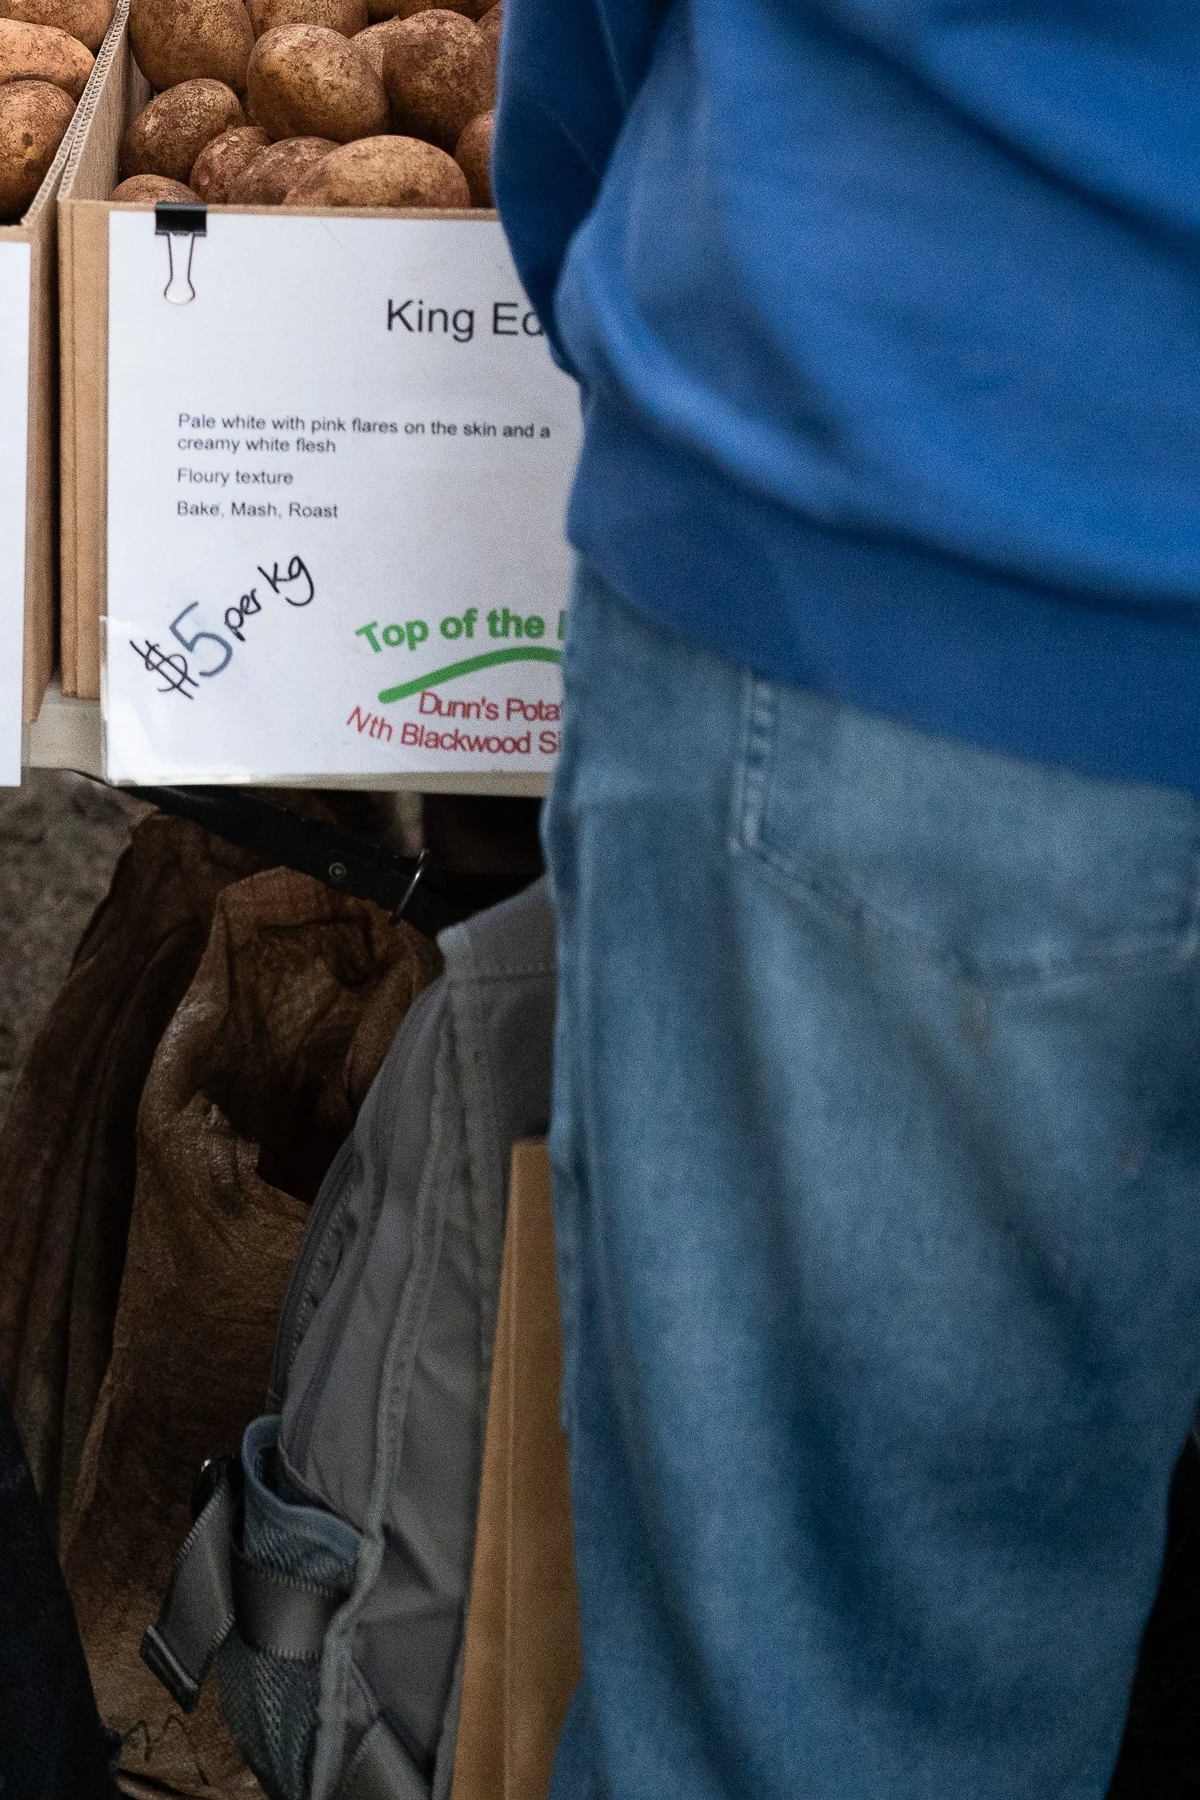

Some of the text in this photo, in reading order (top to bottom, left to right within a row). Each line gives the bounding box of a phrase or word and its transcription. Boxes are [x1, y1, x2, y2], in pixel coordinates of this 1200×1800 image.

[387, 298, 475, 343] King
[178, 413, 551, 439] Pale white with pink flares on the skin and a
[177, 437, 336, 454] creamy white flesh
[177, 467, 294, 488] Floury texture
[177, 500, 338, 520] Bake, Mash, Roast
[129, 600, 234, 701] $5
[224, 588, 262, 642] per
[355, 619, 429, 652] Top
[439, 607, 478, 641] of
[486, 607, 546, 641] the
[419, 690, 563, 723] Dunn's Pota
[346, 705, 394, 743] Nth
[401, 721, 532, 756] Blackwood
